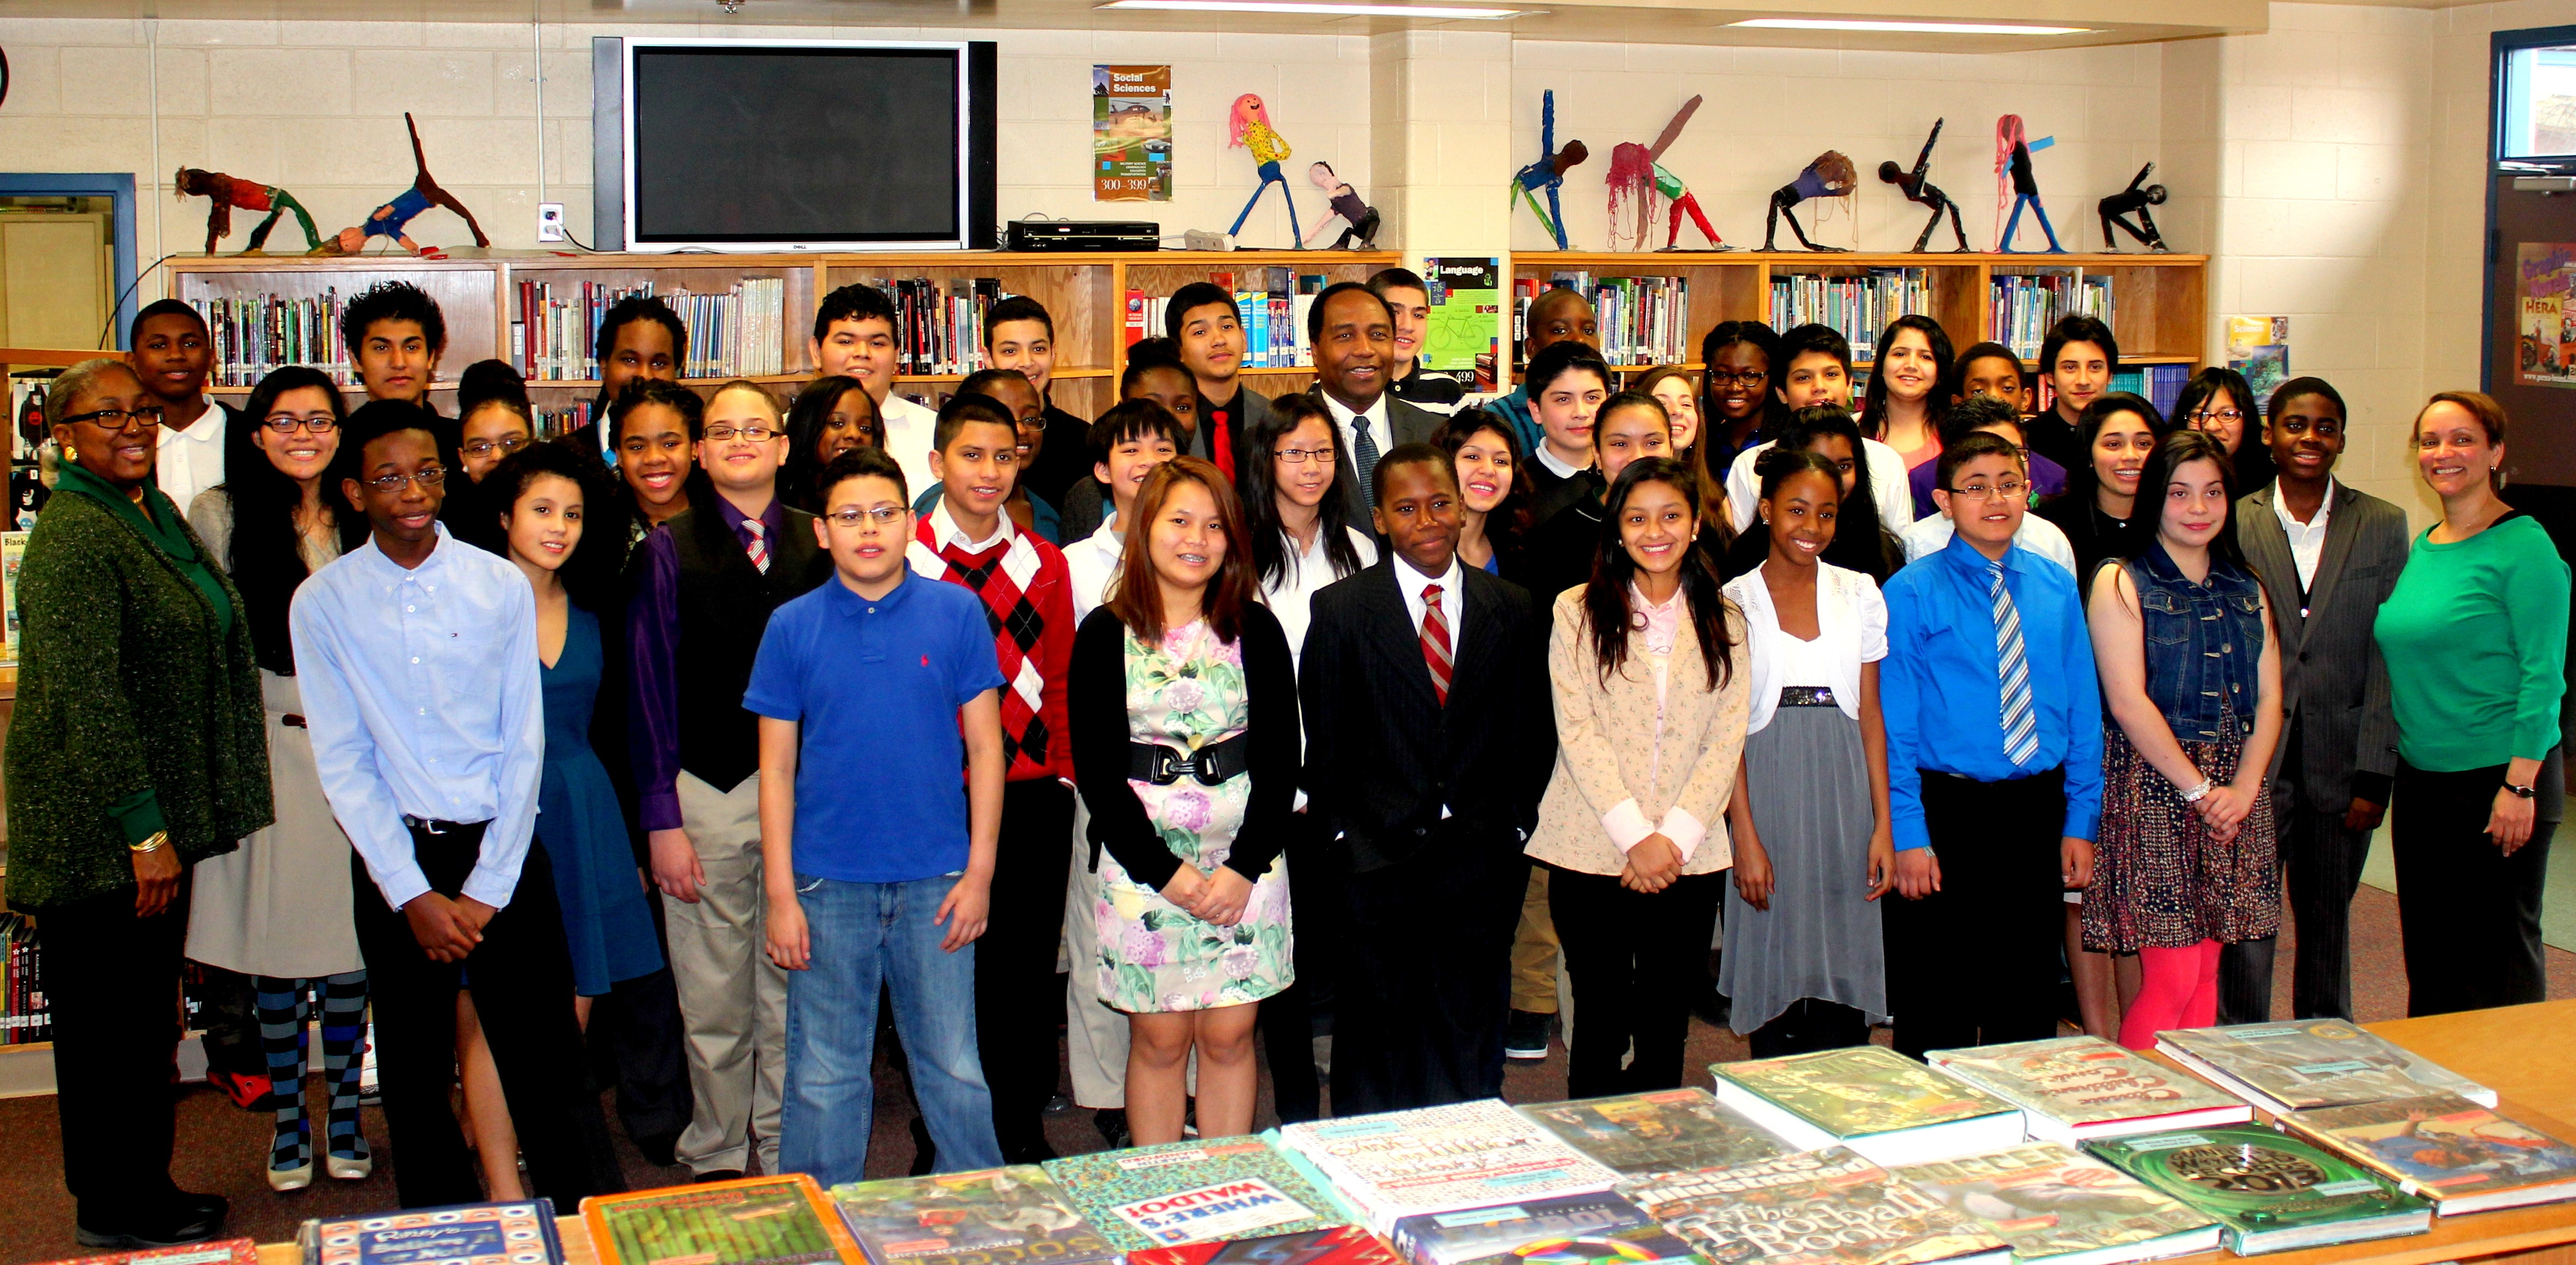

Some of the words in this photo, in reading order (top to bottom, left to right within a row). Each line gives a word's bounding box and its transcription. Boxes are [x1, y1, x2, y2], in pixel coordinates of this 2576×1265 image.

[1113, 73, 1143, 82] Social
[1113, 83, 1157, 92] Sciences
[1440, 265, 1484, 276] Language
[2526, 300, 2558, 314] HERA
[1120, 1149, 1201, 1164] HANDFORD
[1388, 1134, 1544, 1163] million
[1136, 1156, 1191, 1167] MARTIN
[1448, 1159, 1572, 1181] encyclopedia
[1667, 1156, 1823, 1188] Sports
[1893, 1145, 2079, 1181] SOCCER
[2171, 1154, 2296, 1171] WORLD
[2178, 1161, 2313, 1179] RECORDS
[1635, 1156, 1870, 1207] Illustrated
[2189, 1169, 2322, 1192] 2013
[1123, 1182, 1266, 1219] WALDO?
[1138, 1193, 1284, 1230] WHERE'S
[1689, 1187, 1946, 1247] Football
[1725, 1203, 1798, 1225] The
[1739, 1221, 1911, 1257] Book
